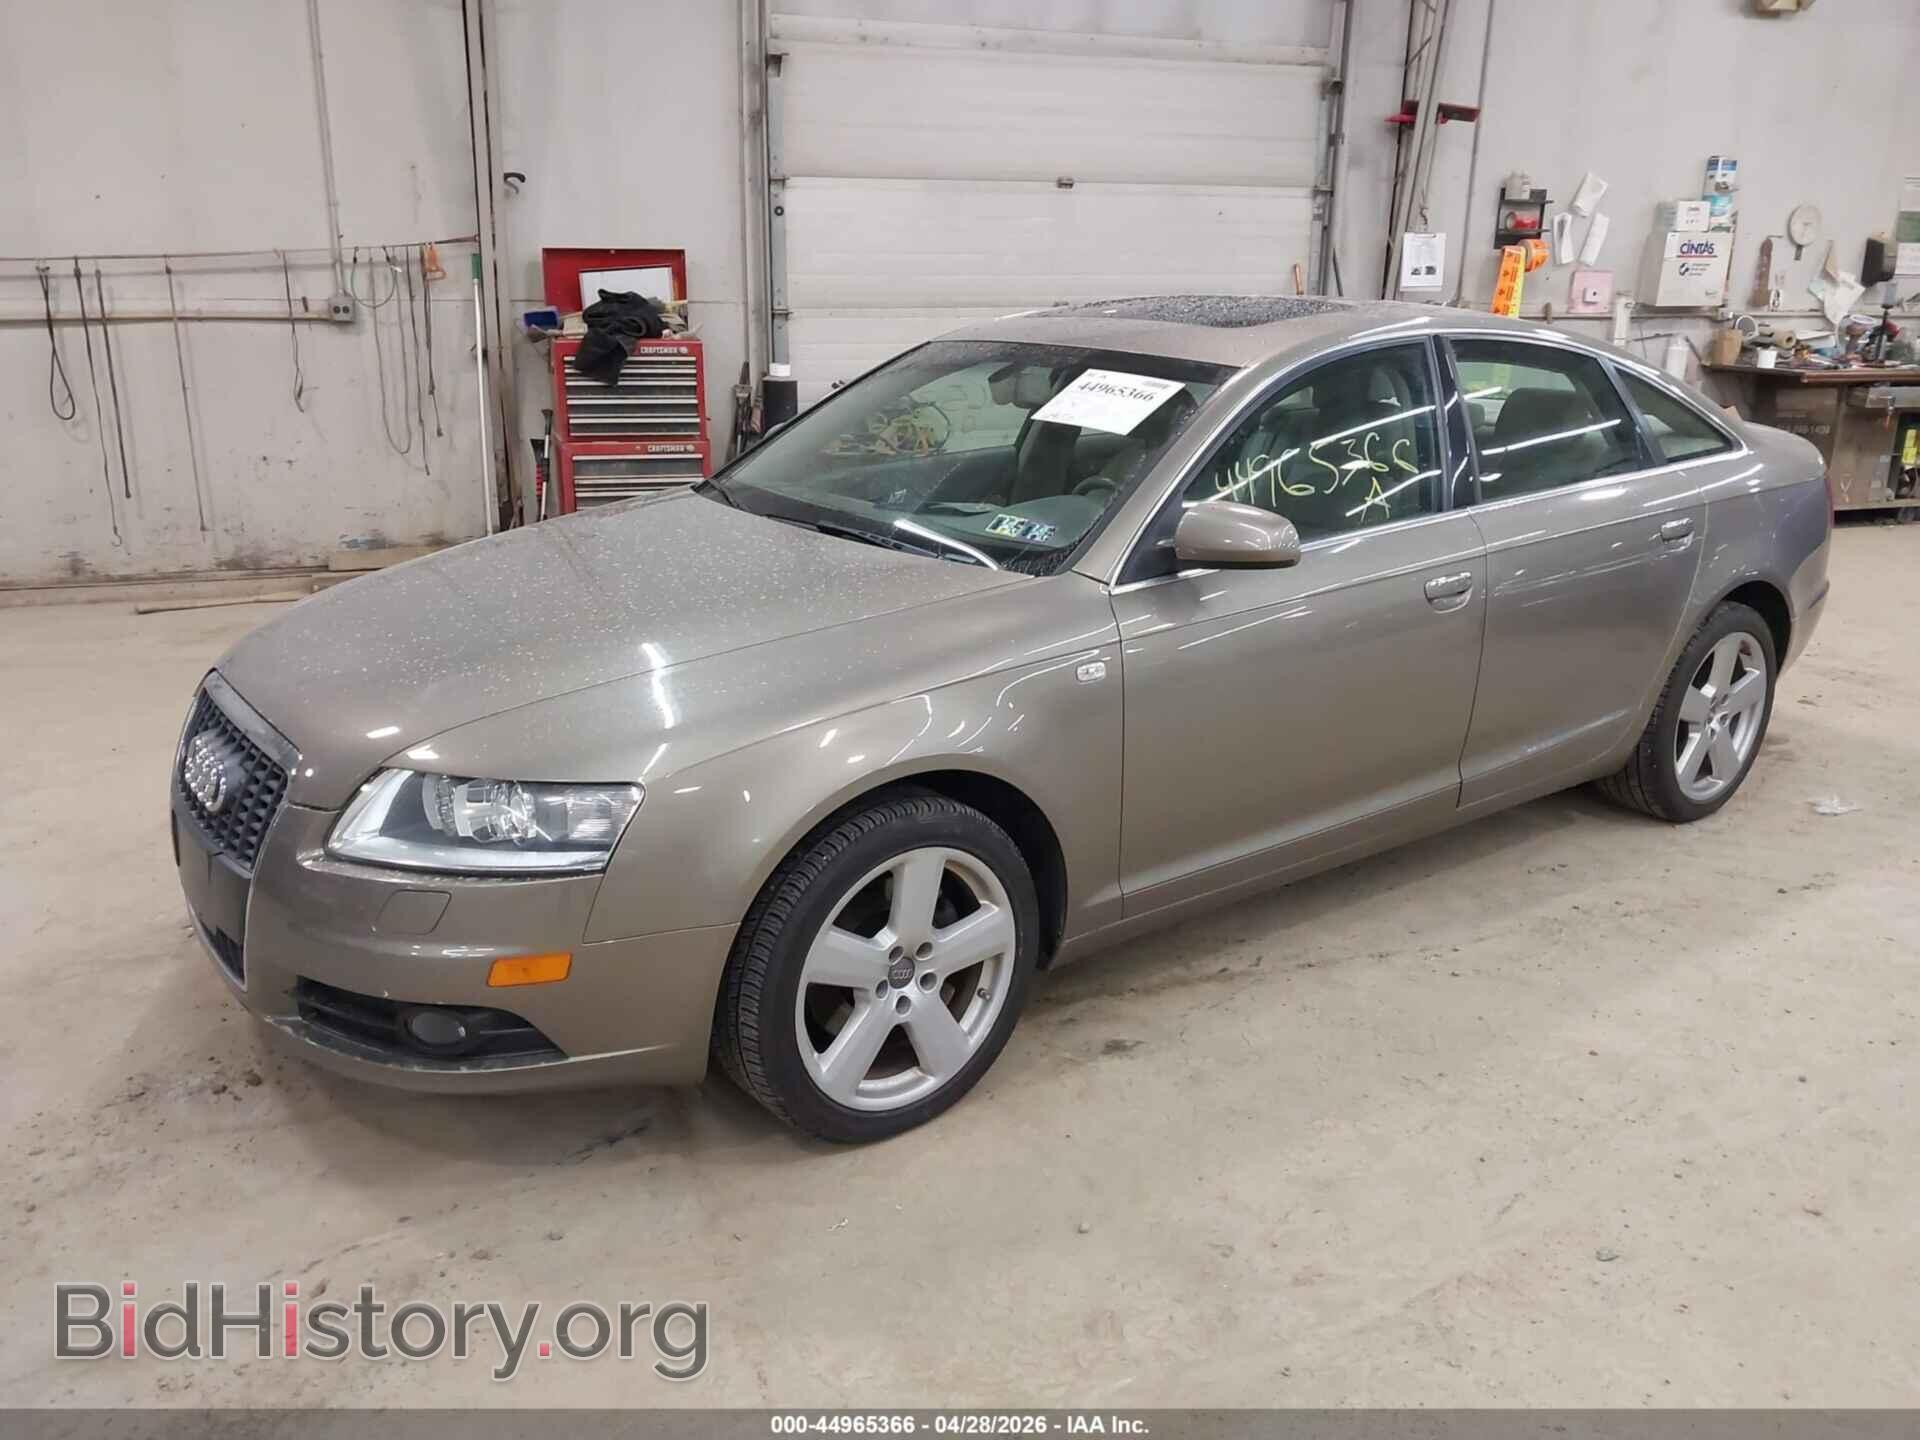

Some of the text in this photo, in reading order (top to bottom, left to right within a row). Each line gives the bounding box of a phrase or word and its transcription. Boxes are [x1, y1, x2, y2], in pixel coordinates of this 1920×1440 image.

[1679, 239, 1715, 255] CINTAS
[640, 346, 678, 354] CRAFTSMAN
[1078, 381, 1156, 402] 44965366
[647, 444, 685, 453] CRAFTSMAN
